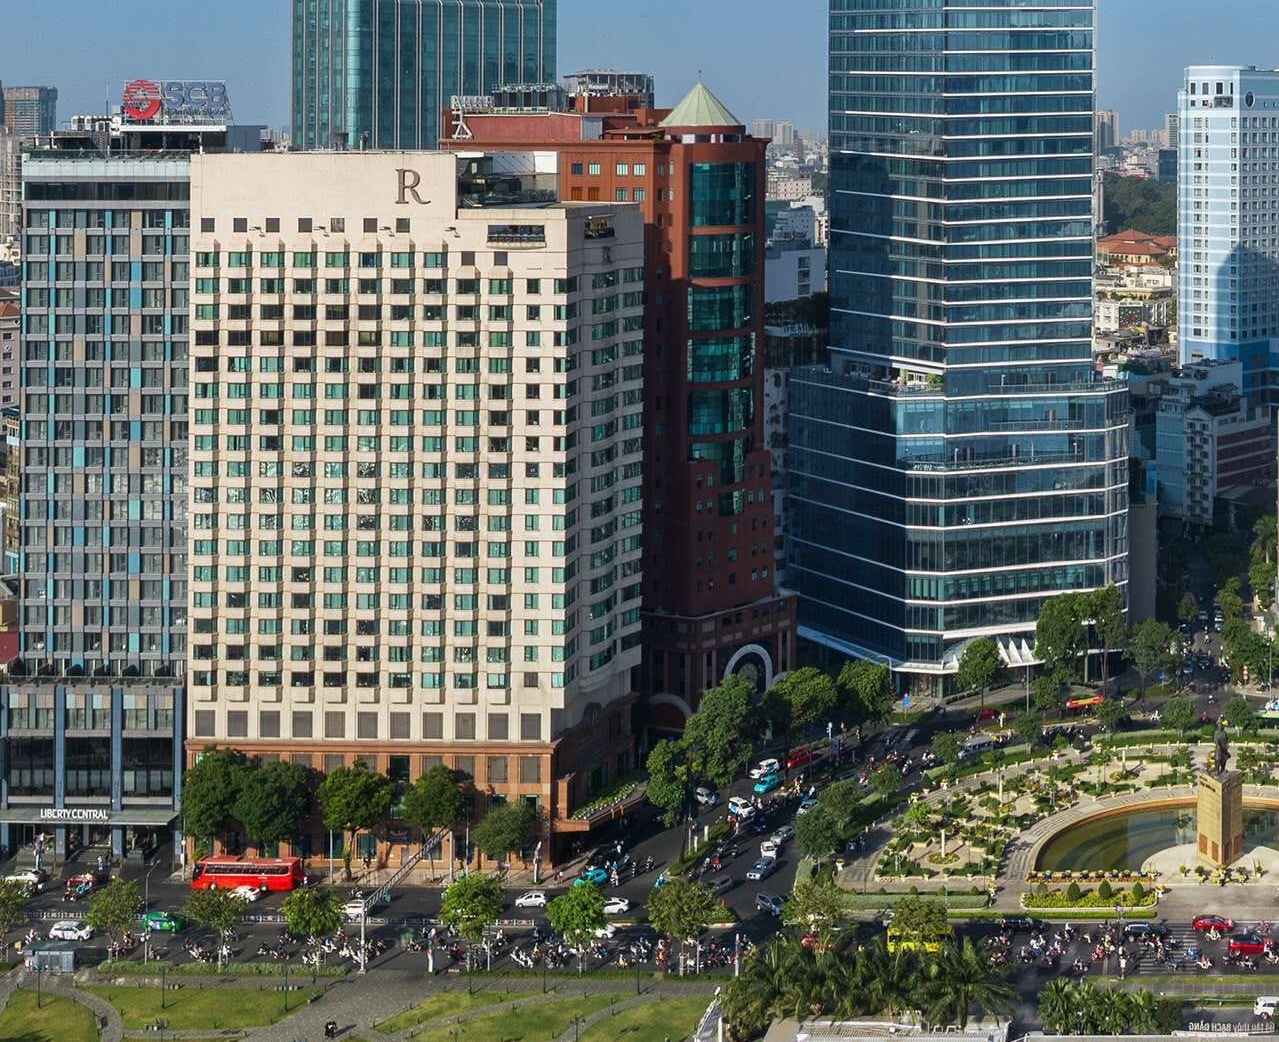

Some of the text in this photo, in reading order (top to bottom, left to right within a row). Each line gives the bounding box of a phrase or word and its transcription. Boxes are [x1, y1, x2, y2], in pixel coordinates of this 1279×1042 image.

[164, 81, 225, 107] SCB
[395, 168, 432, 205] R
[40, 808, 109, 820] LIBERTY CENTRAL
